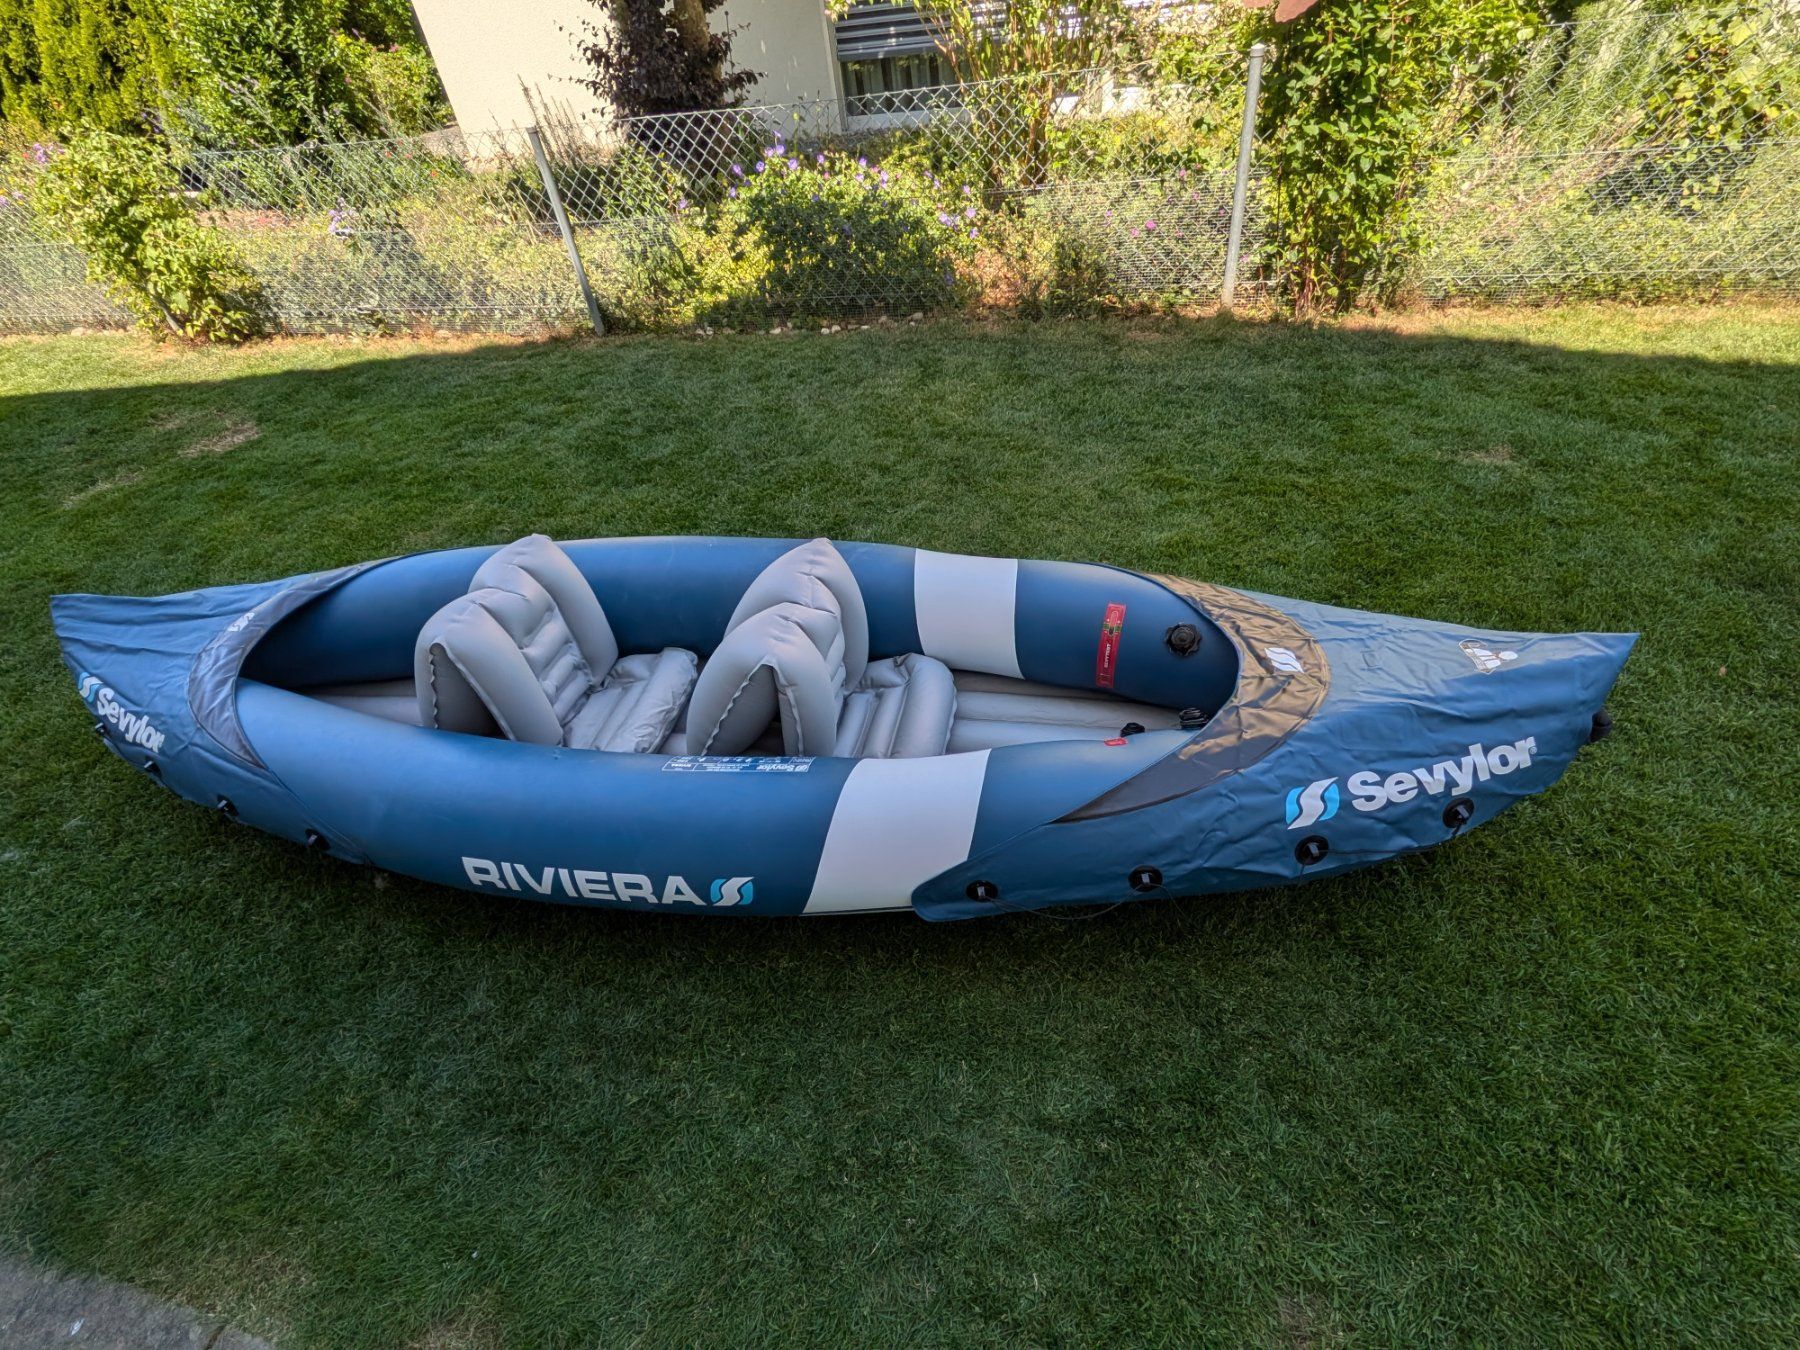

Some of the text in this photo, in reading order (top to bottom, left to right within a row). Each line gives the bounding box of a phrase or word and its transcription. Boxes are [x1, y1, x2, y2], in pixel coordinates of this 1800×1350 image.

[97, 687, 165, 753] Sevylor
[1347, 736, 1537, 812] Sevylor
[461, 856, 707, 906] RIVIERA
